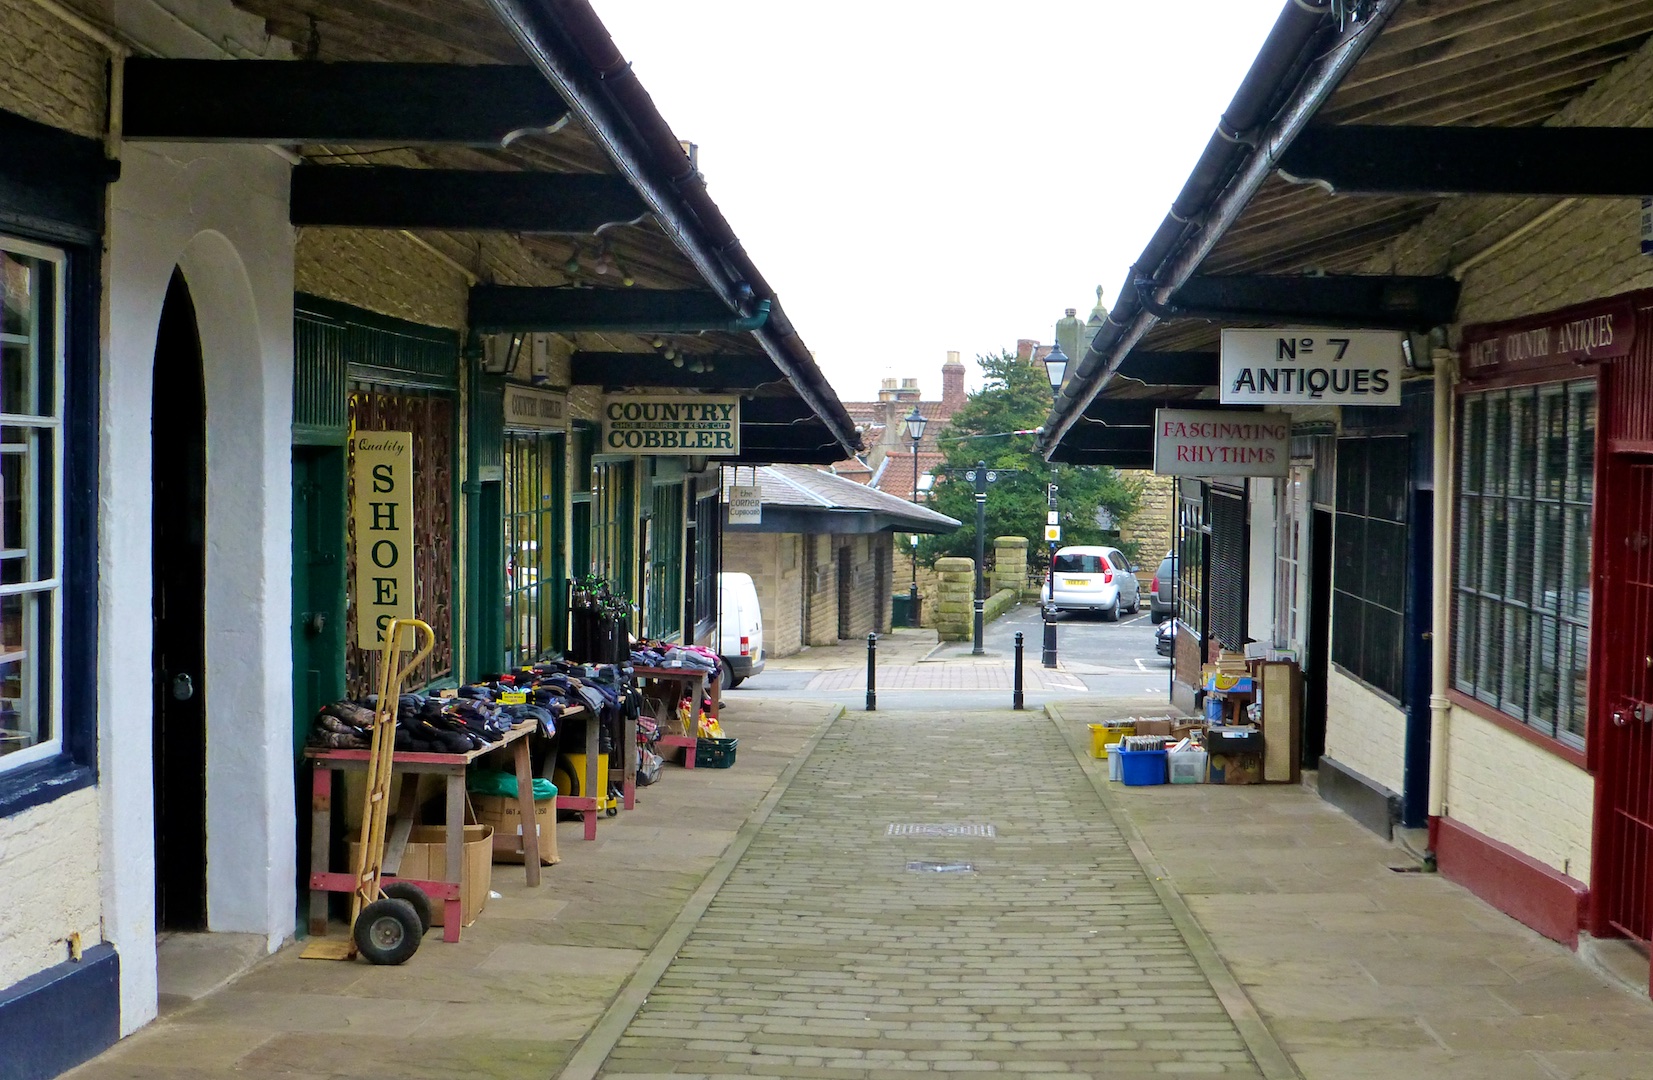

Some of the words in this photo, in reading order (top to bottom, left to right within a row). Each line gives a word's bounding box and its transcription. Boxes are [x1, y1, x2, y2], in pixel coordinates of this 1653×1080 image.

[1506, 326, 1552, 361] COUNTRY
[1557, 314, 1613, 355] ANTIQUES
[1326, 338, 1351, 362] 7
[1231, 368, 1390, 399] ANTIQUES
[606, 402, 736, 421] COUNTRY
[614, 422, 637, 430] SHOE
[640, 422, 674, 430] REPAIRS
[678, 422, 685, 430] &
[688, 422, 710, 430] KEYS
[1163, 420, 1286, 440] FASCINATING
[358, 438, 405, 456] Quality
[607, 430, 734, 449] COBBLER
[1177, 445, 1276, 464] RHYTHMS
[740, 489, 753, 498] the
